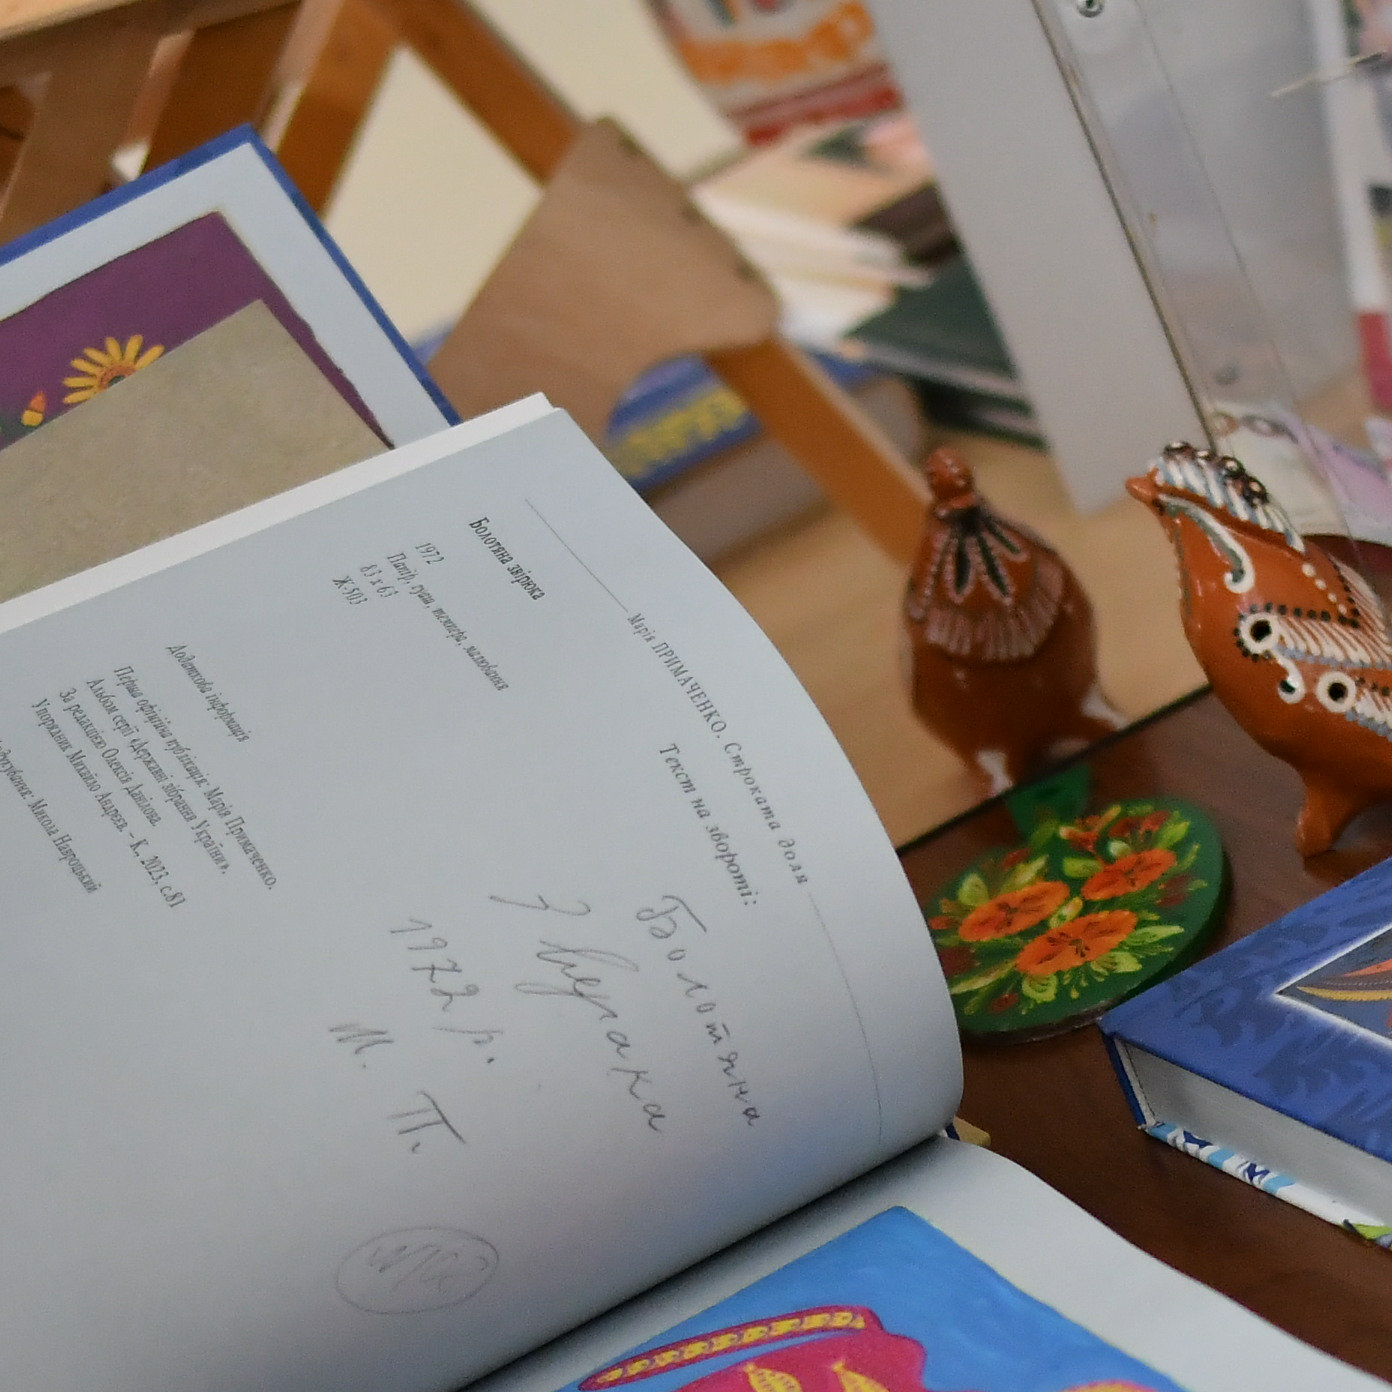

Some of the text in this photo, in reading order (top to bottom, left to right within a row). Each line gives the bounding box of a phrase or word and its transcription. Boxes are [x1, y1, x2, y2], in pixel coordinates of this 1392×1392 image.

[375, 585, 400, 598] 63
[386, 551, 419, 585] Папір,
[462, 645, 510, 692] малювання
[414, 542, 445, 565] 1972
[468, 516, 546, 601] Болотяна звірюка
[58, 687, 162, 828] За редакцією Олексія Данілова.
[85, 678, 120, 716] Альбом
[111, 714, 140, 738] серії
[161, 782, 198, 823] зібрання
[164, 644, 252, 743] Додаткова інформація
[626, 612, 809, 885] Марія ПРИМАЧЕНКО. Строката доля
[26, 797, 60, 838] Микола
[52, 833, 103, 894] Навроцький
[30, 697, 73, 753] Упорядник
[65, 749, 102, 792] Михайло
[139, 855, 170, 886] 2023,
[113, 665, 278, 891] Перша офіційна публікація: Марія Примаченко.
[658, 742, 759, 906] Текст на звороті:
[388, 917, 481, 1013] 1972
[634, 894, 761, 1127] Болотяна
